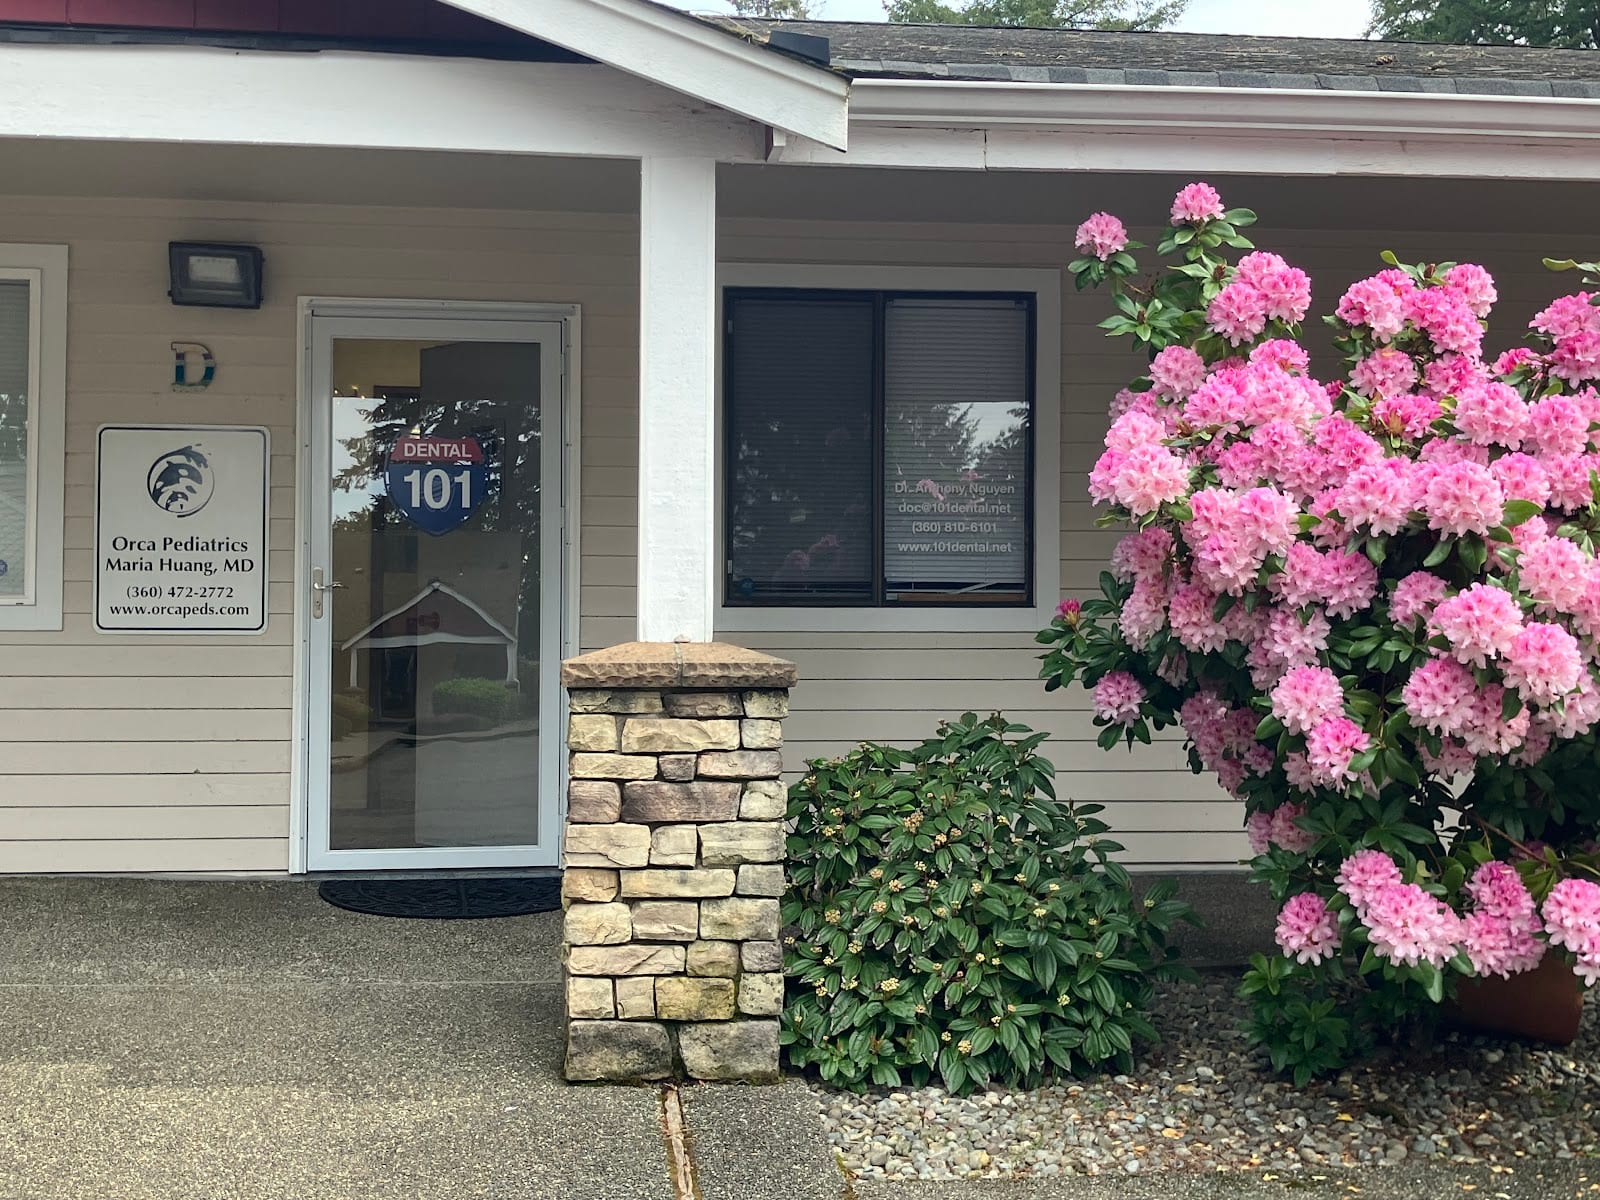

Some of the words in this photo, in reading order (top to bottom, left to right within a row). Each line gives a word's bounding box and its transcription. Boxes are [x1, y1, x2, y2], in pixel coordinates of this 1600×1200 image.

[171, 341, 216, 391] D
[403, 442, 472, 458] DENTAL
[403, 468, 471, 509] 101
[915, 482, 966, 496] Anhony
[969, 482, 1015, 496] Nguyen
[898, 501, 1011, 513] doc@101dental.net
[911, 520, 941, 534] (360)
[944, 521, 997, 533] 810-6101
[112, 536, 156, 552] Orca
[162, 535, 248, 552] Pediatrics
[897, 541, 1012, 553] www.101dental.net
[105, 557, 153, 572] Maria
[159, 558, 218, 577] Huang,
[223, 558, 254, 572] MD
[126, 585, 162, 599] (360)
[167, 586, 234, 598] 472-2772
[109, 602, 249, 618] www.orcapeds.com
